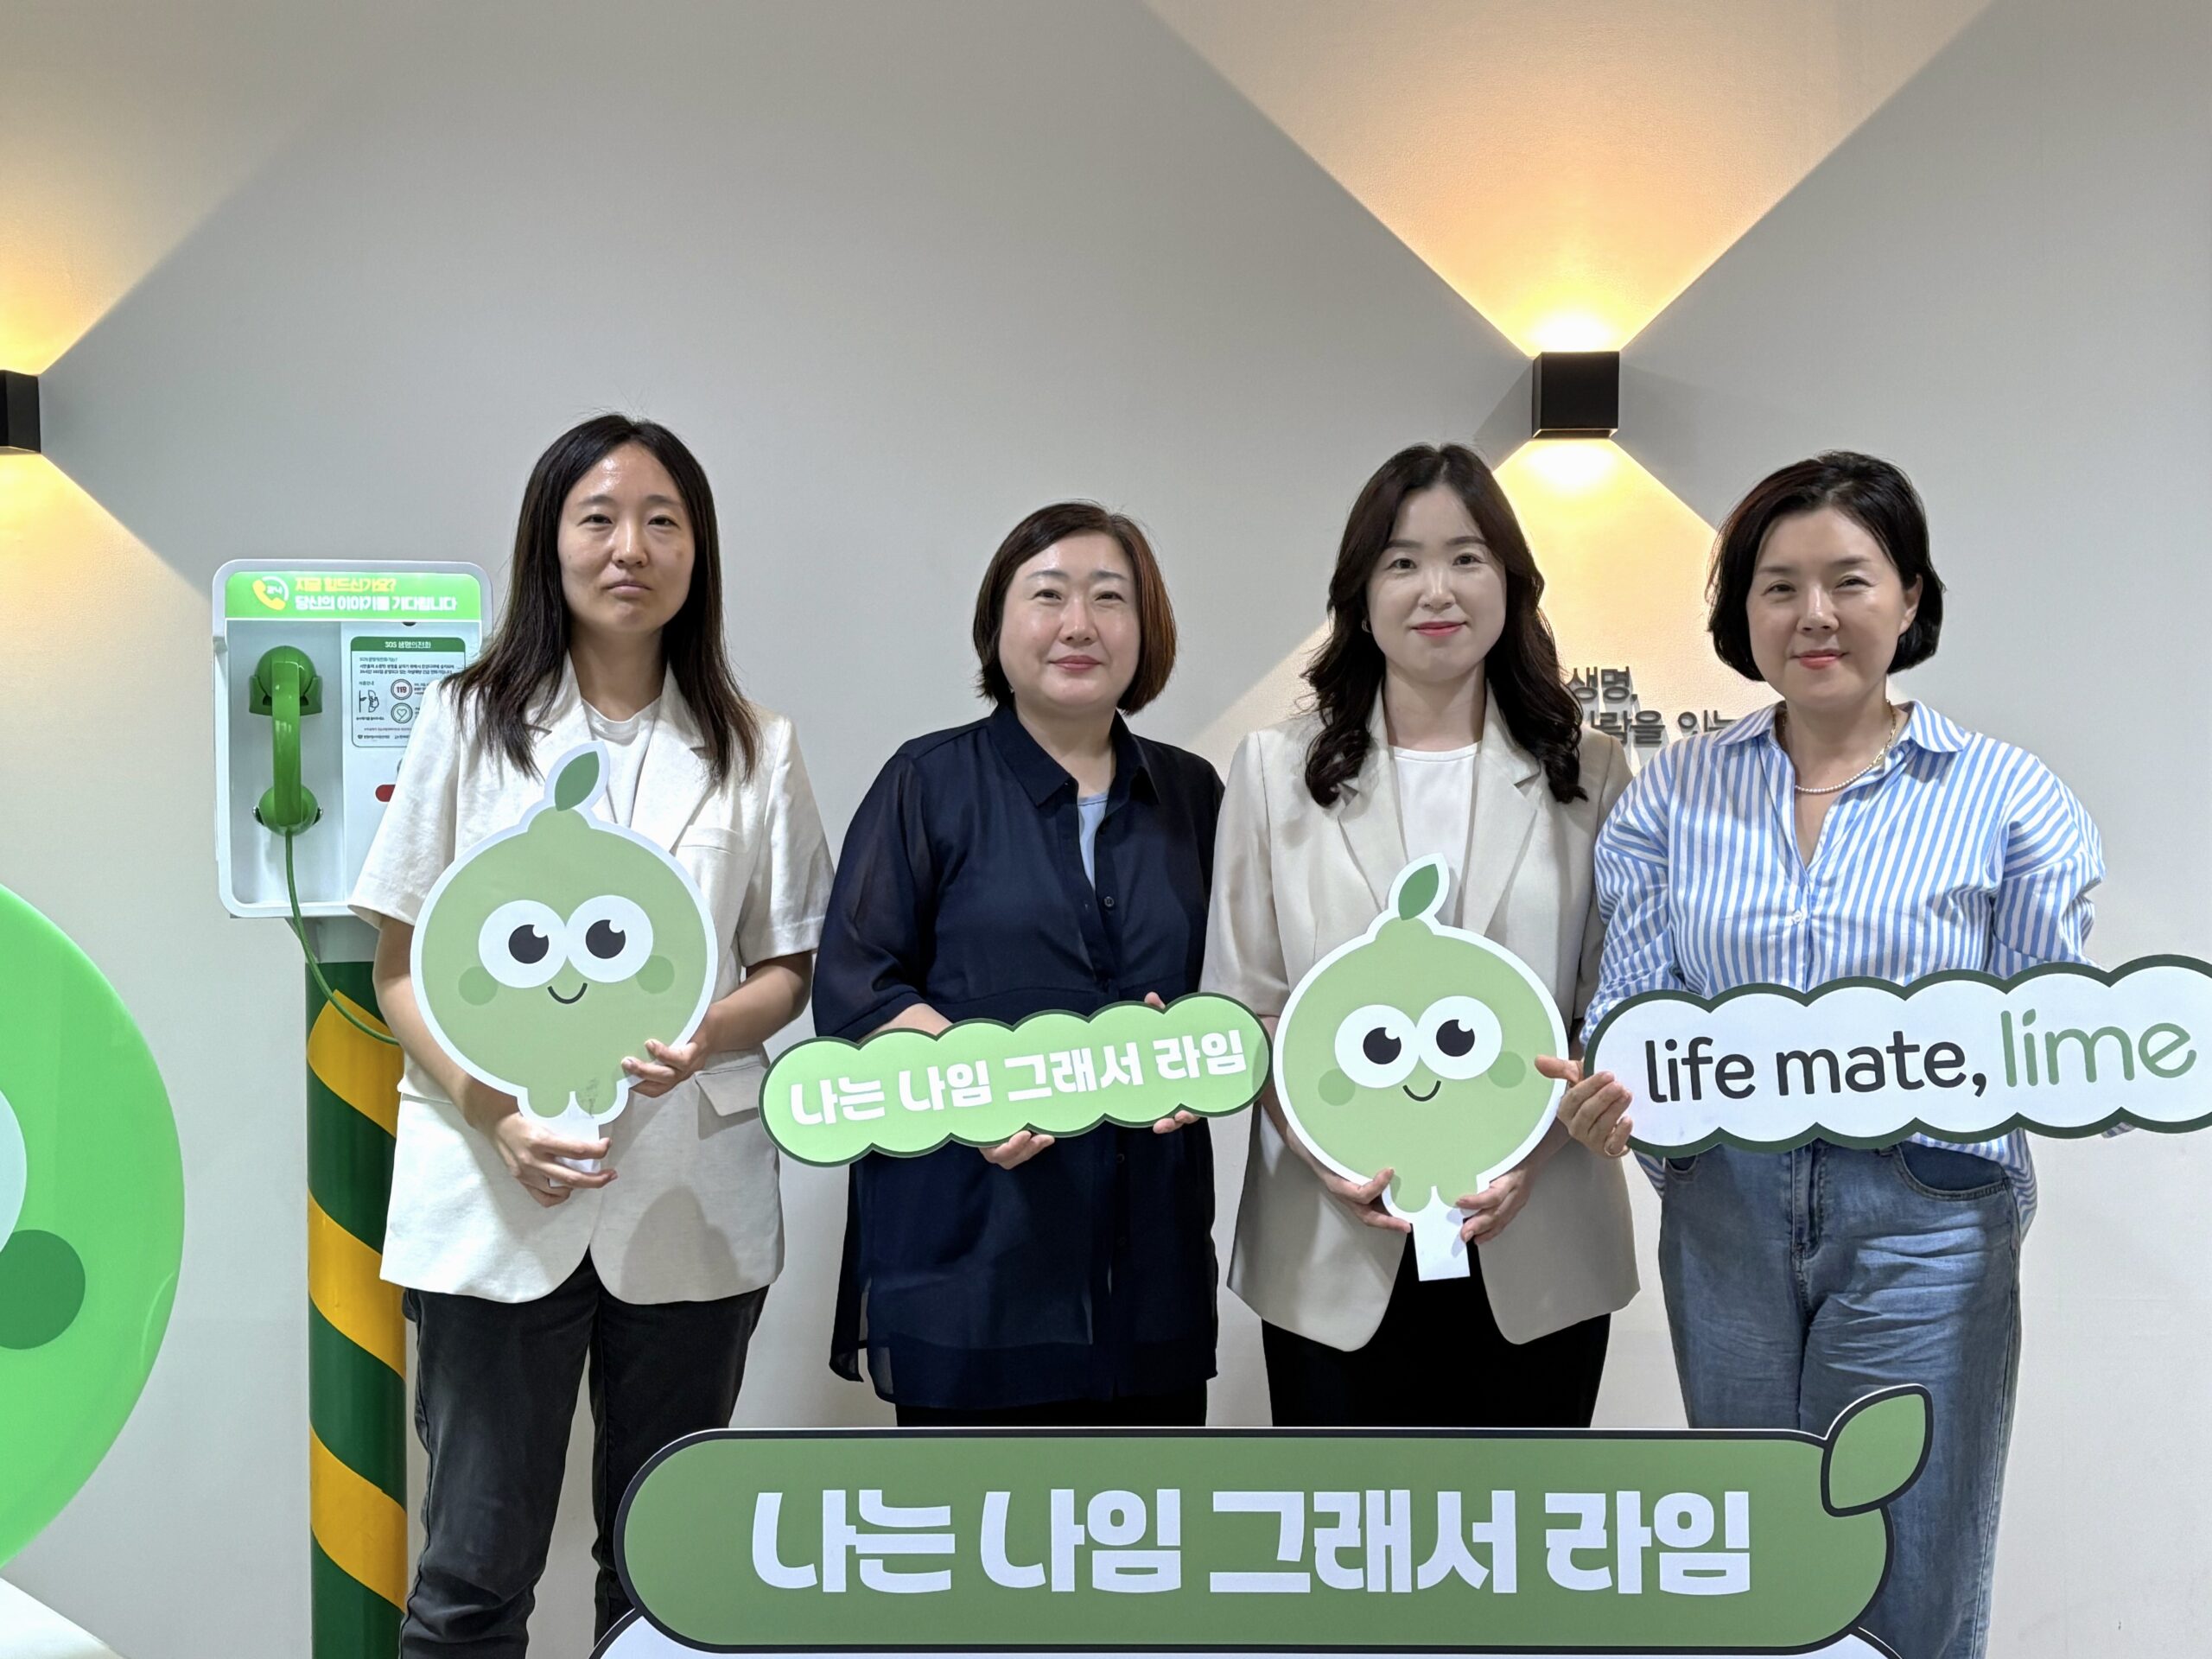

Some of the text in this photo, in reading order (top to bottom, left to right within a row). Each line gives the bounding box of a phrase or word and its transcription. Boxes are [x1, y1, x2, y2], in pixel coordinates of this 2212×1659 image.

[296, 578, 397, 593] 지금 힘드신가요?
[296, 596, 457, 611] 당신의 이야기를 기다립니다
[1567, 665, 1637, 702] 생명,
[791, 1029, 1247, 1125] 나는 나임 그래서 라임
[1645, 1007, 2197, 1103] life mate, lime
[752, 1489, 1751, 1596] 나는 나임 그래서 라임
